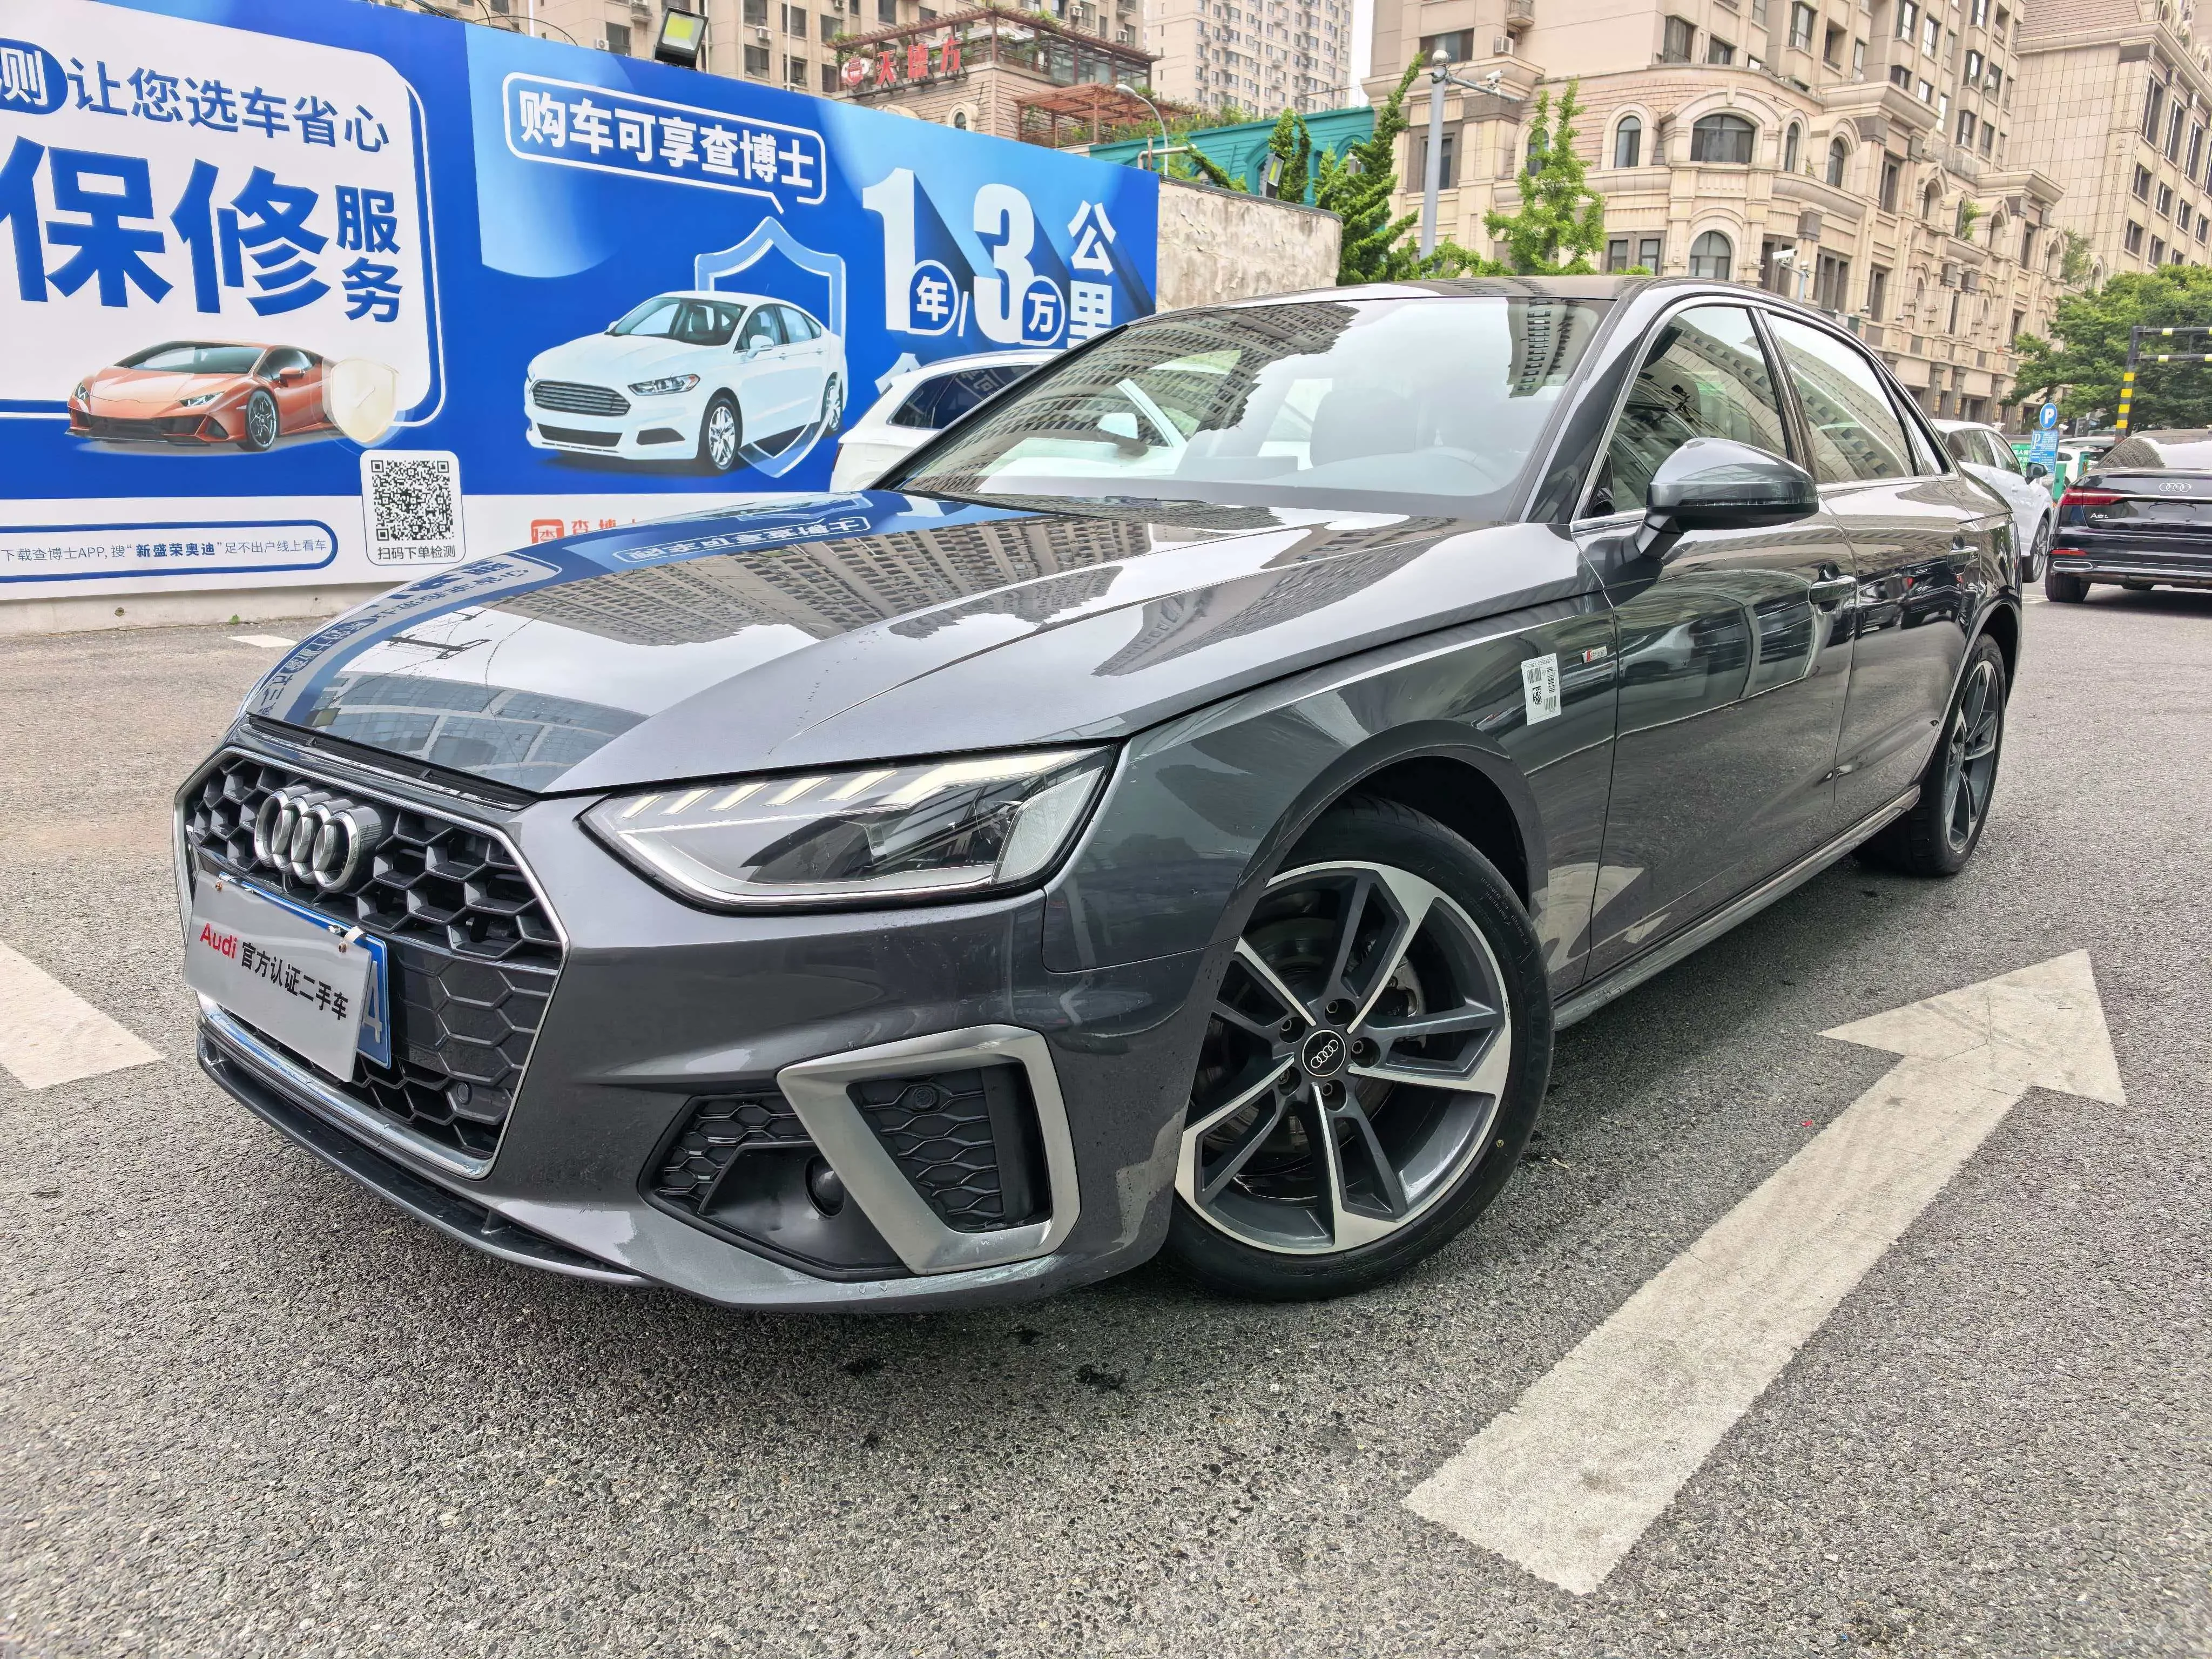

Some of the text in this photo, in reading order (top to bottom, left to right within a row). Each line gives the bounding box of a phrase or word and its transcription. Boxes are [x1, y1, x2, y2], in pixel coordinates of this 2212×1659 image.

[67, 57, 390, 153] 让您选车省心
[518, 89, 814, 189] 购车可享查博士
[0, 135, 332, 317] 保修
[335, 185, 403, 323] 服务
[2044, 408, 2054, 424] P
[378, 545, 455, 560] 扫码下单检测
[199, 922, 349, 1021] Audi 官方认证二手车
[361, 960, 383, 1044] 4
